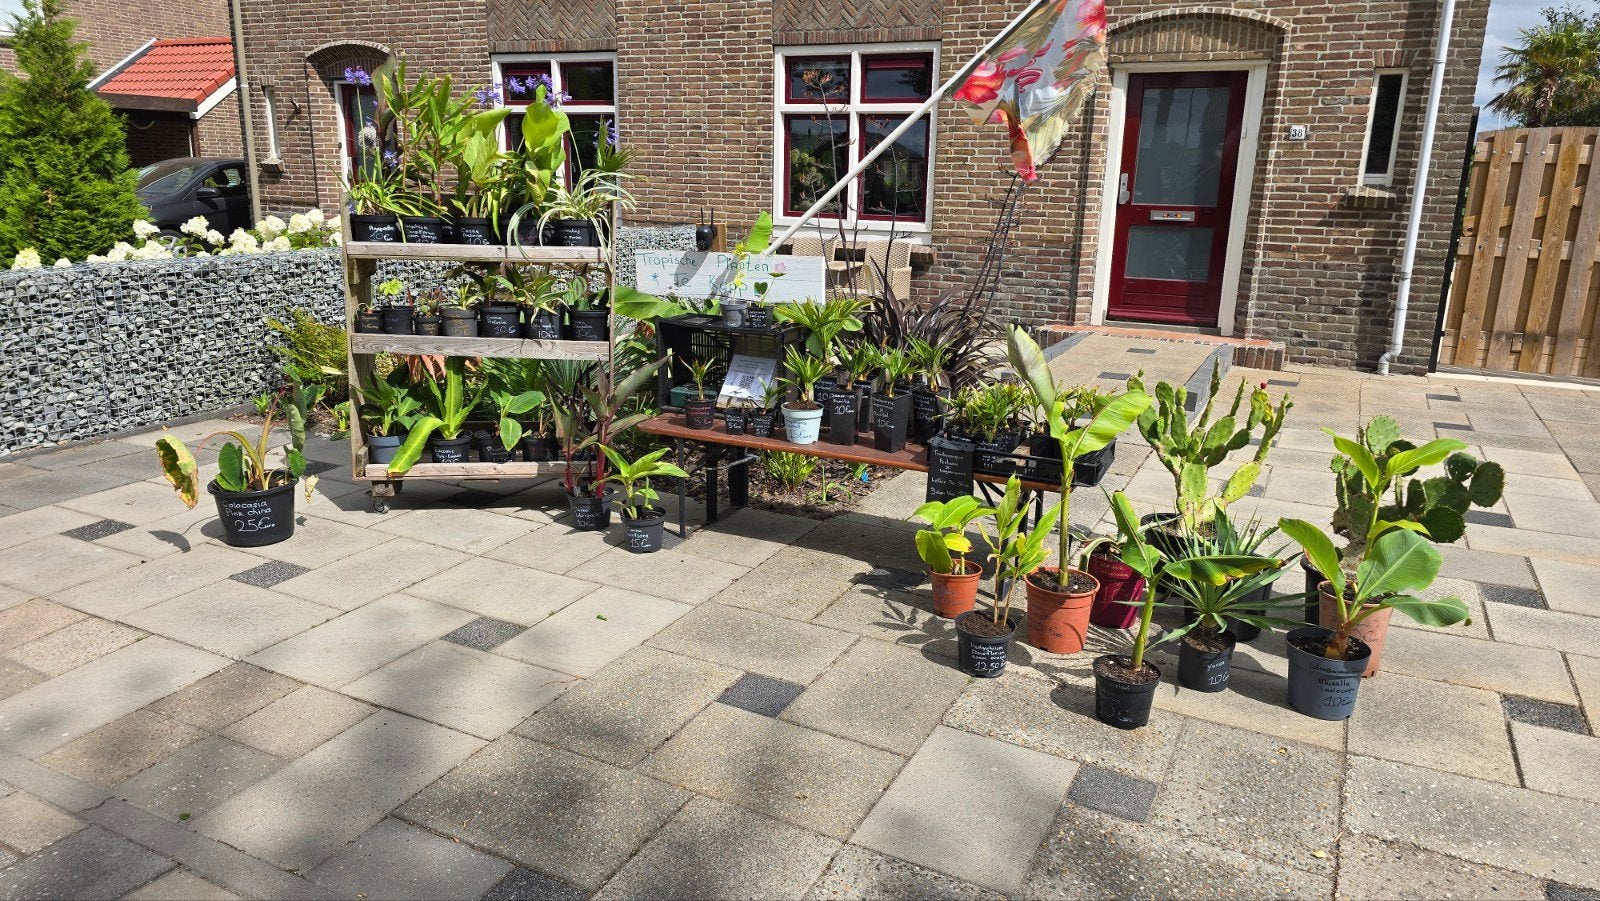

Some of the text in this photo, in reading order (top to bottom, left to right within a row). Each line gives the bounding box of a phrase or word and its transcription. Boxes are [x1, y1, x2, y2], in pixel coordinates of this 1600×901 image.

[1291, 128, 1303, 138] 38
[636, 252, 769, 272] Tropische Planten
[669, 272, 748, 297] Te Koop
[222, 500, 268, 509] Colocasia
[1319, 678, 1351, 687] Musella
